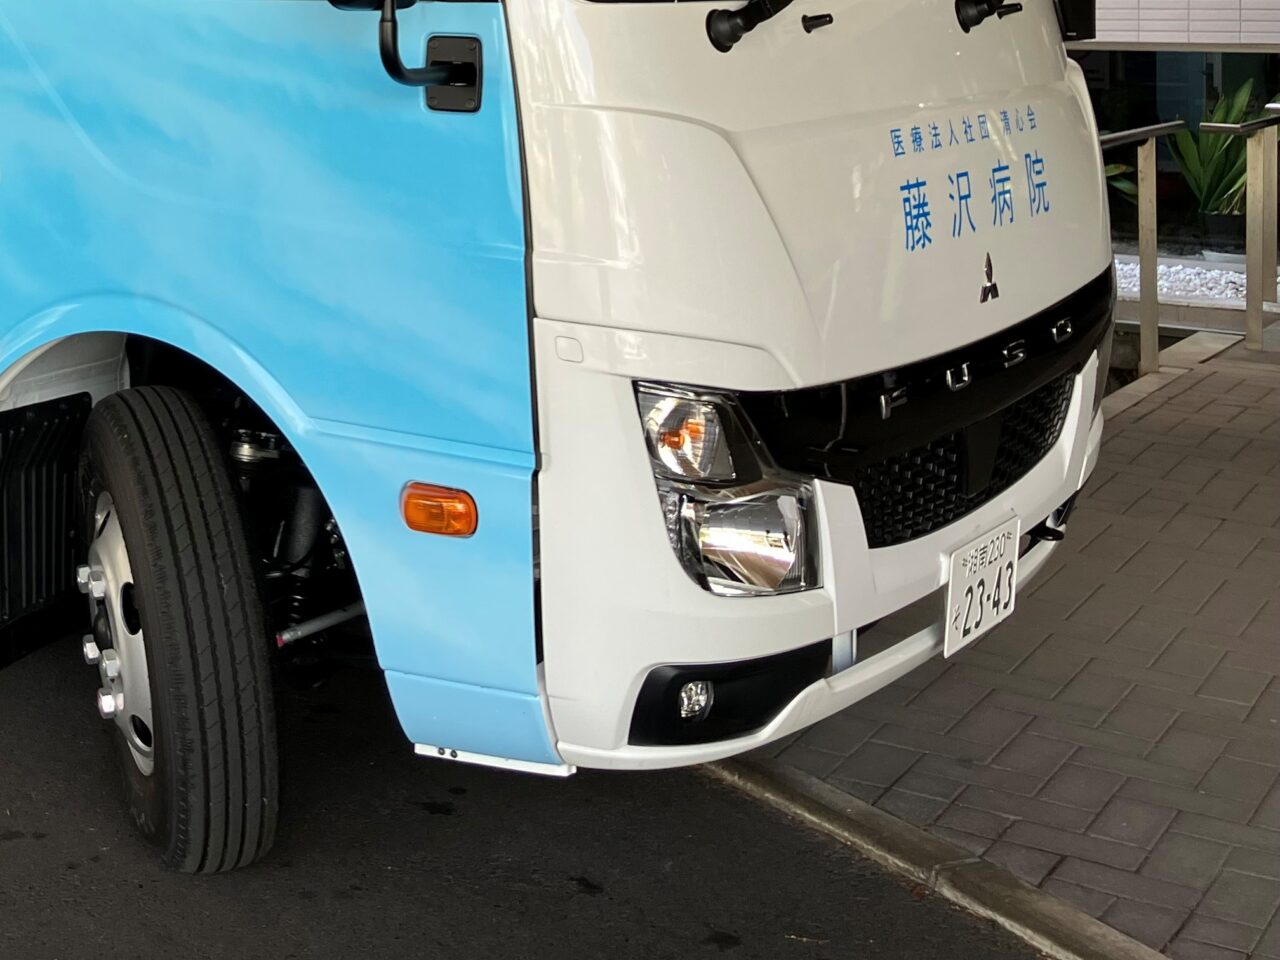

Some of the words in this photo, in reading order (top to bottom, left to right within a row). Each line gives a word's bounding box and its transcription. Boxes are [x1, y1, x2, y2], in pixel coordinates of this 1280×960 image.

[890, 114, 990, 157] 医療法人社団
[1000, 105, 1037, 136] 清心会
[900, 150, 1050, 251] 藤沢病院
[880, 317, 1072, 420] FUSO
